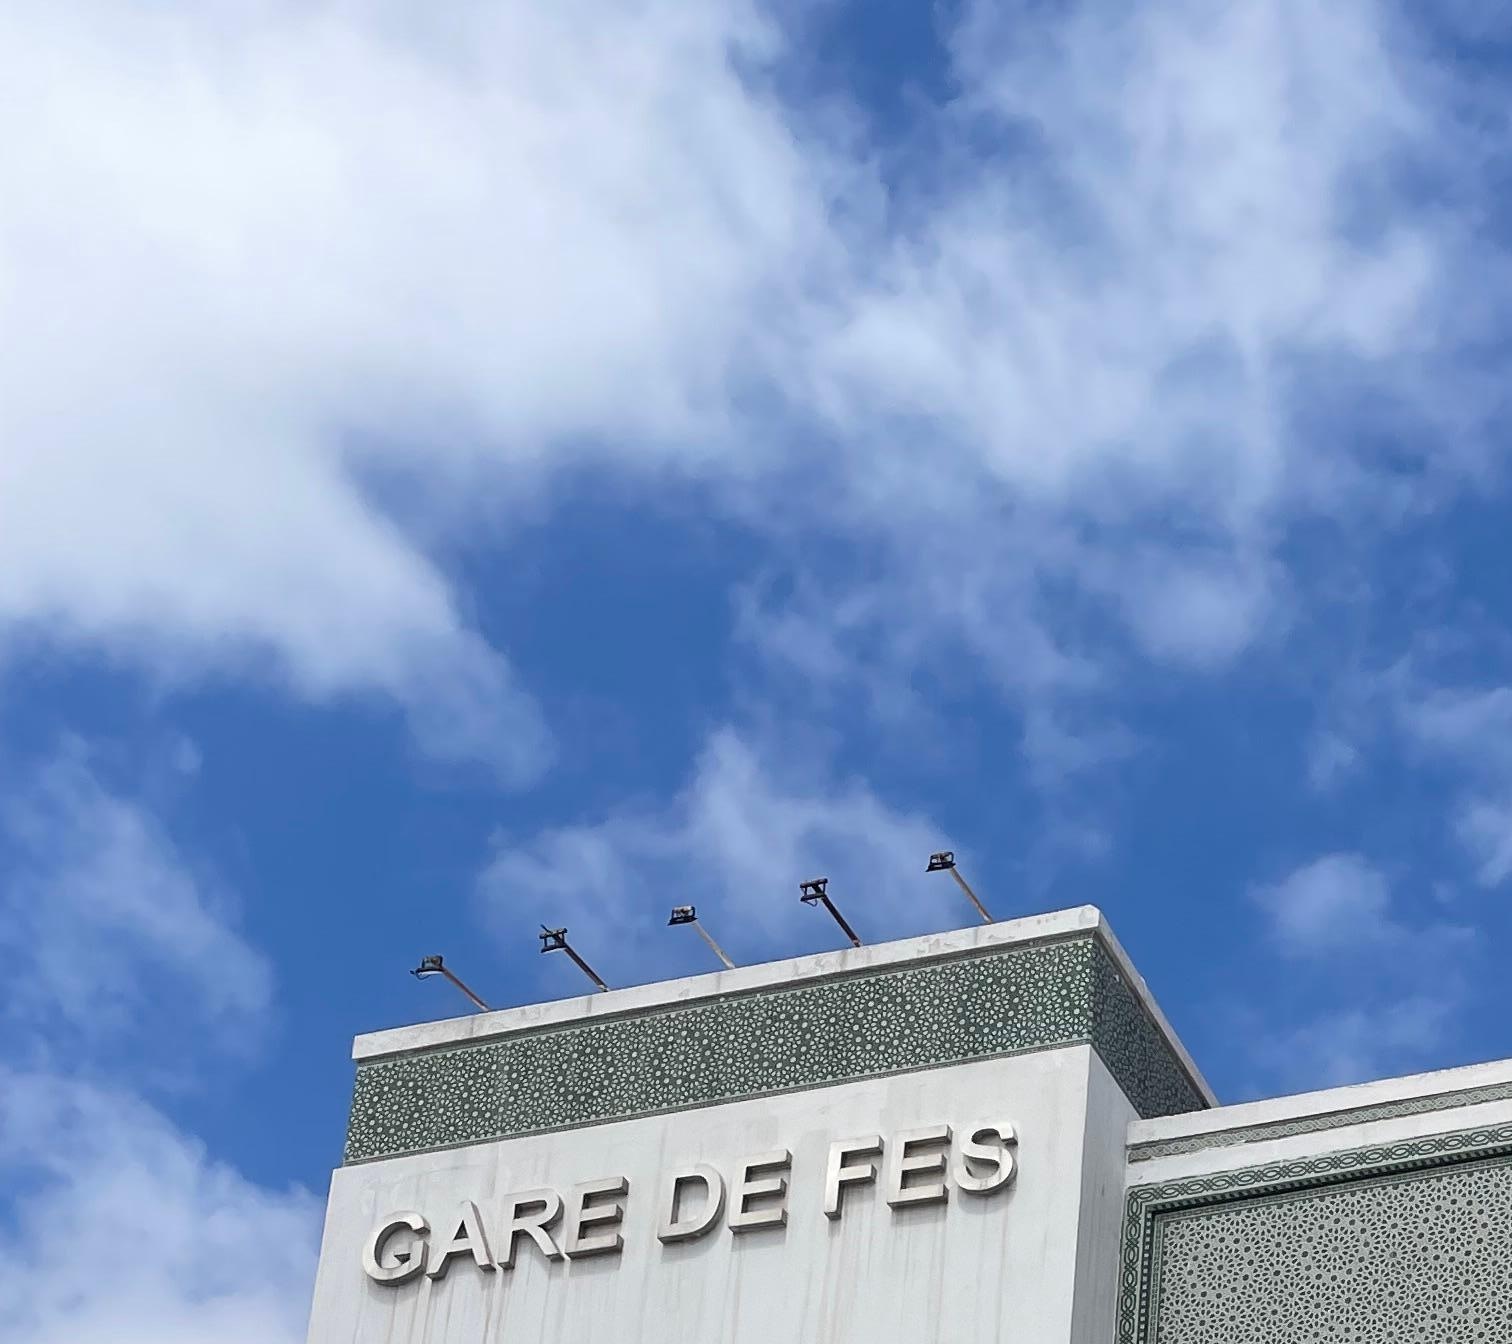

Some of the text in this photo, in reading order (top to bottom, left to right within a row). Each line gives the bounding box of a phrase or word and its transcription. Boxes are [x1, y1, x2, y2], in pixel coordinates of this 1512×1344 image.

[361, 1121, 1020, 1287] GARE DE FES
